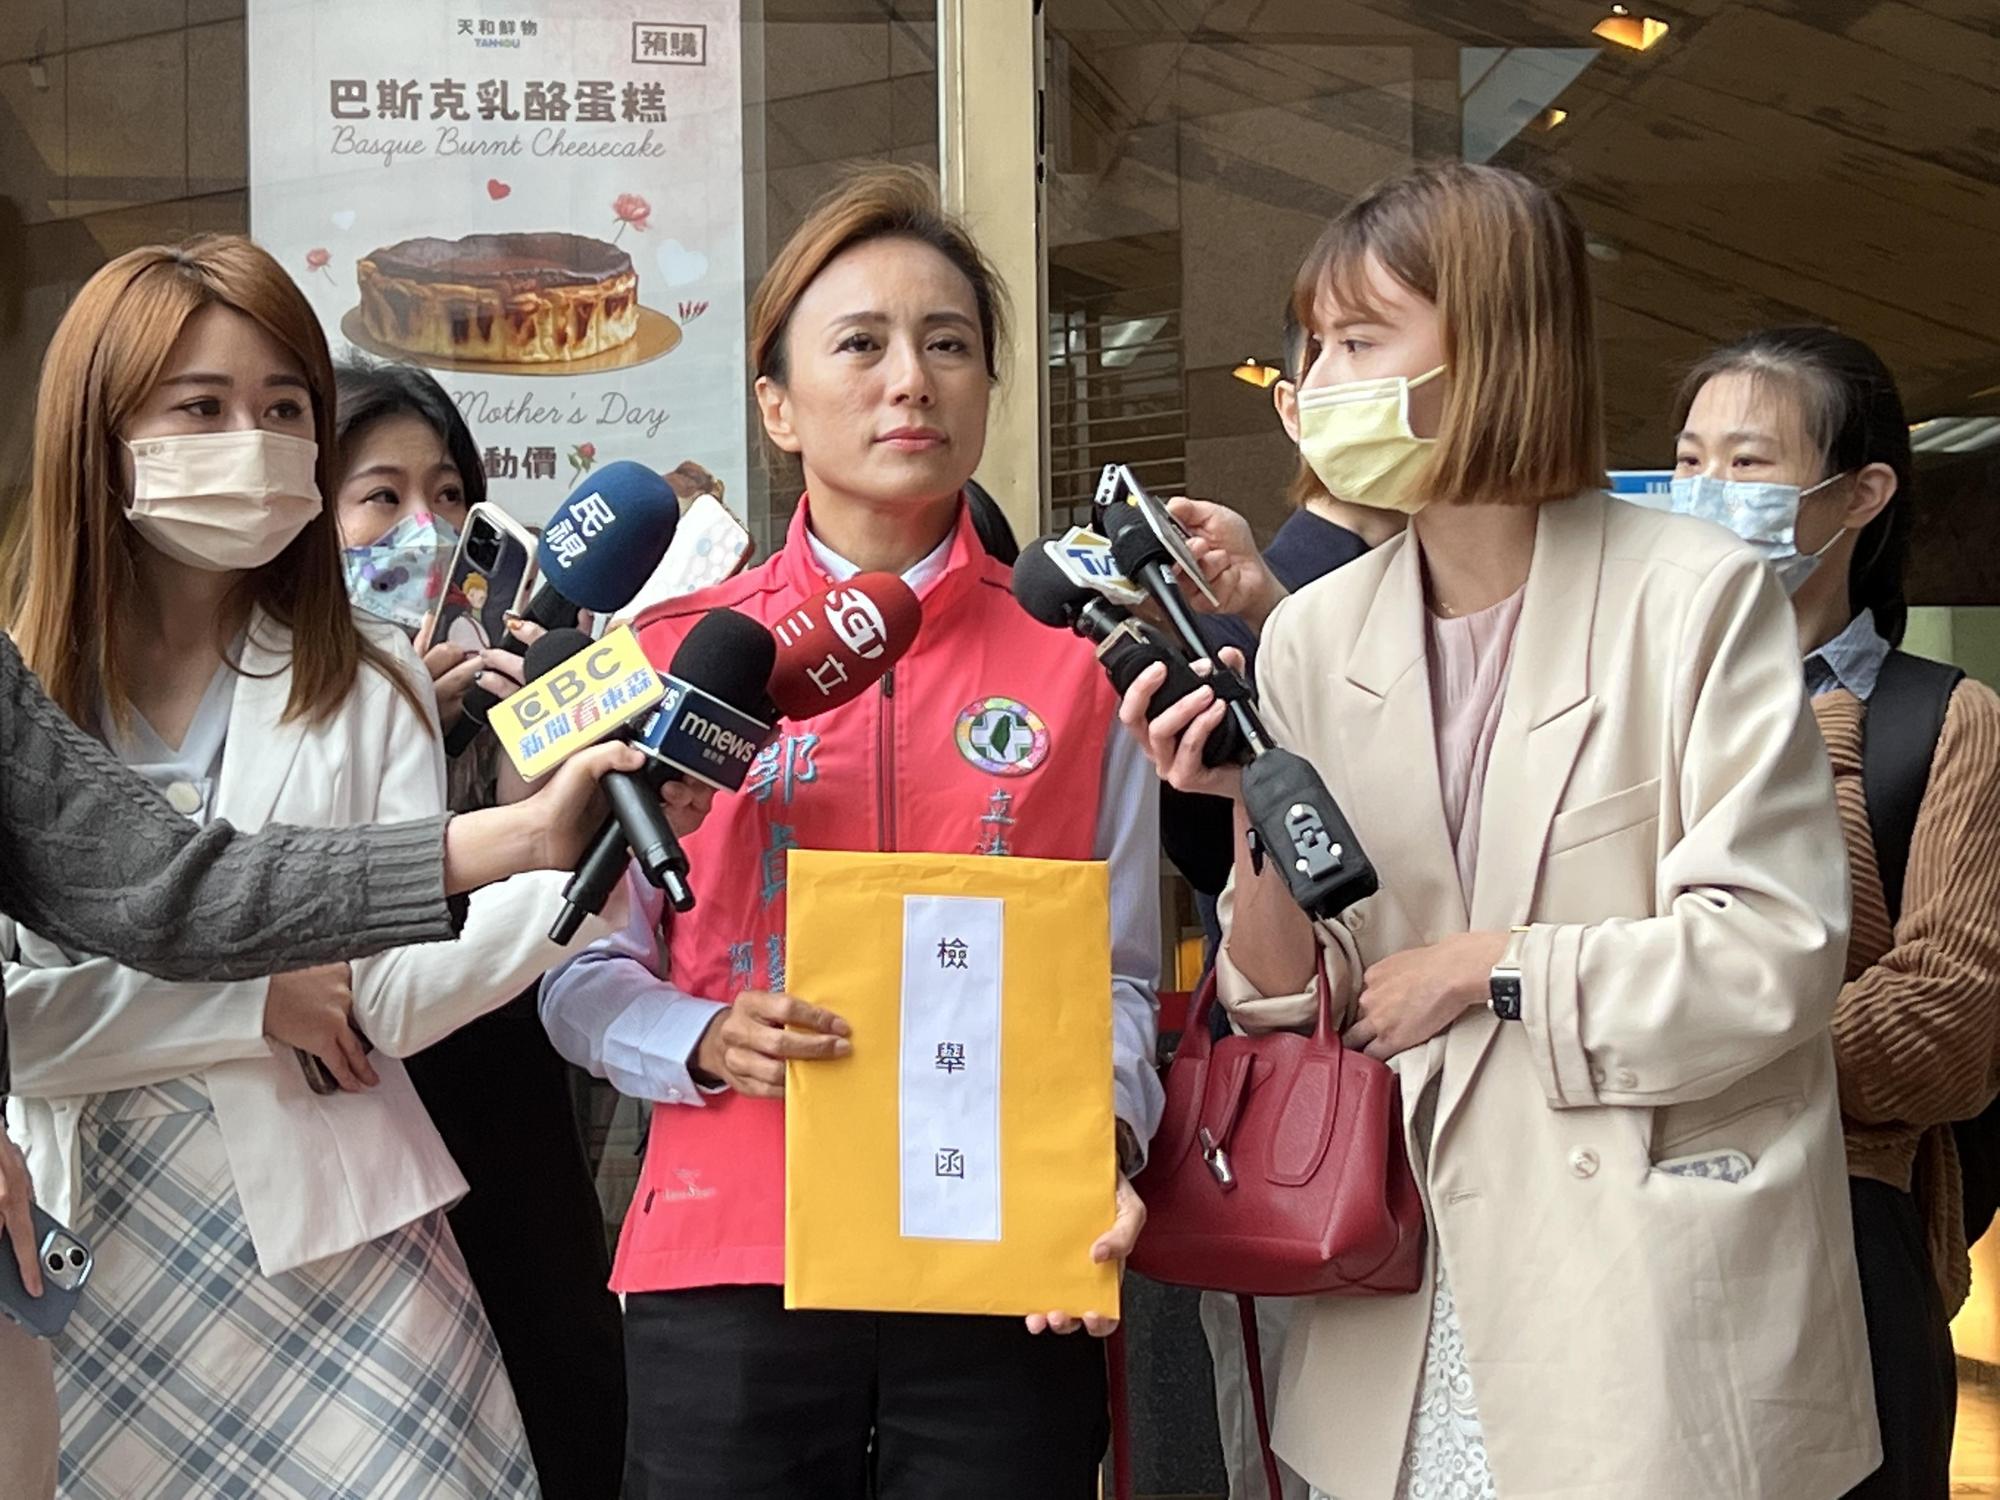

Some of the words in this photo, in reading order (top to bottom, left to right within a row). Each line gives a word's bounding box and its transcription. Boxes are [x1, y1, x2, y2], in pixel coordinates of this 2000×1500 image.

[457, 18, 538, 36] 天和鮮物
[641, 29, 698, 58] 預購
[330, 78, 668, 122] 巴斯克乳酪蛋糕
[331, 124, 427, 167] Basque
[434, 126, 523, 157] Burnt
[532, 127, 666, 158] Cheesecake
[451, 390, 587, 425] Mother's
[596, 391, 670, 438] Day
[545, 491, 616, 569] 民視
[680, 711, 756, 762] mnews
[935, 936, 969, 1180] 檢舉函
